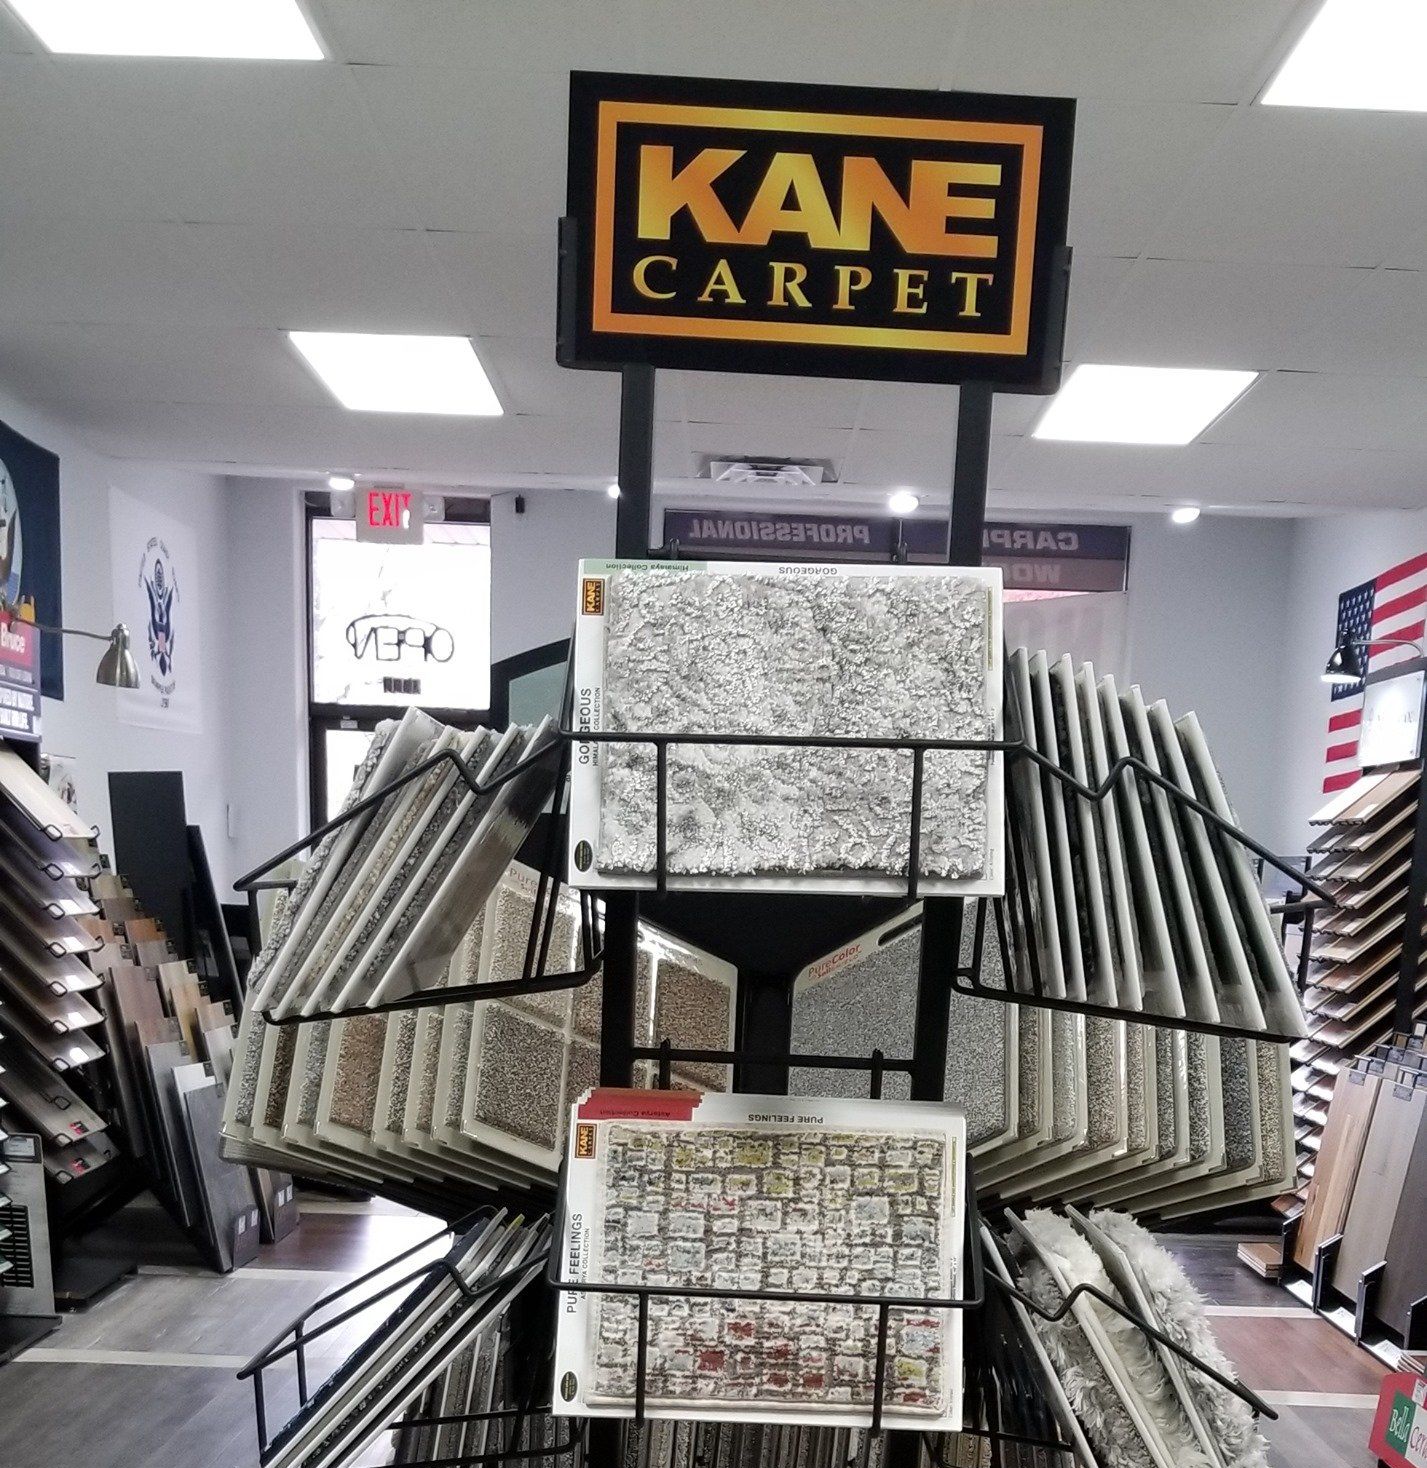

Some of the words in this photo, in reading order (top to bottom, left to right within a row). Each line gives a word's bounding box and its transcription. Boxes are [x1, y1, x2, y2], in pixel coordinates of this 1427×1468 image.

[638, 144, 1002, 259] KANE
[632, 255, 994, 318] CARPET
[368, 490, 412, 529] EXIT
[606, 563, 648, 571] Collection
[779, 566, 838, 575] GORGEOUS
[586, 581, 596, 612] KANE
[593, 687, 601, 731] COLLECTION
[748, 1114, 795, 1123] FEELINGS
[797, 1115, 824, 1123] PURE
[579, 1126, 589, 1156] KANE
[568, 1213, 583, 1275] FEELINGS
[582, 1228, 590, 1269] COLLECTION
[1389, 1405, 1410, 1443] Bella
